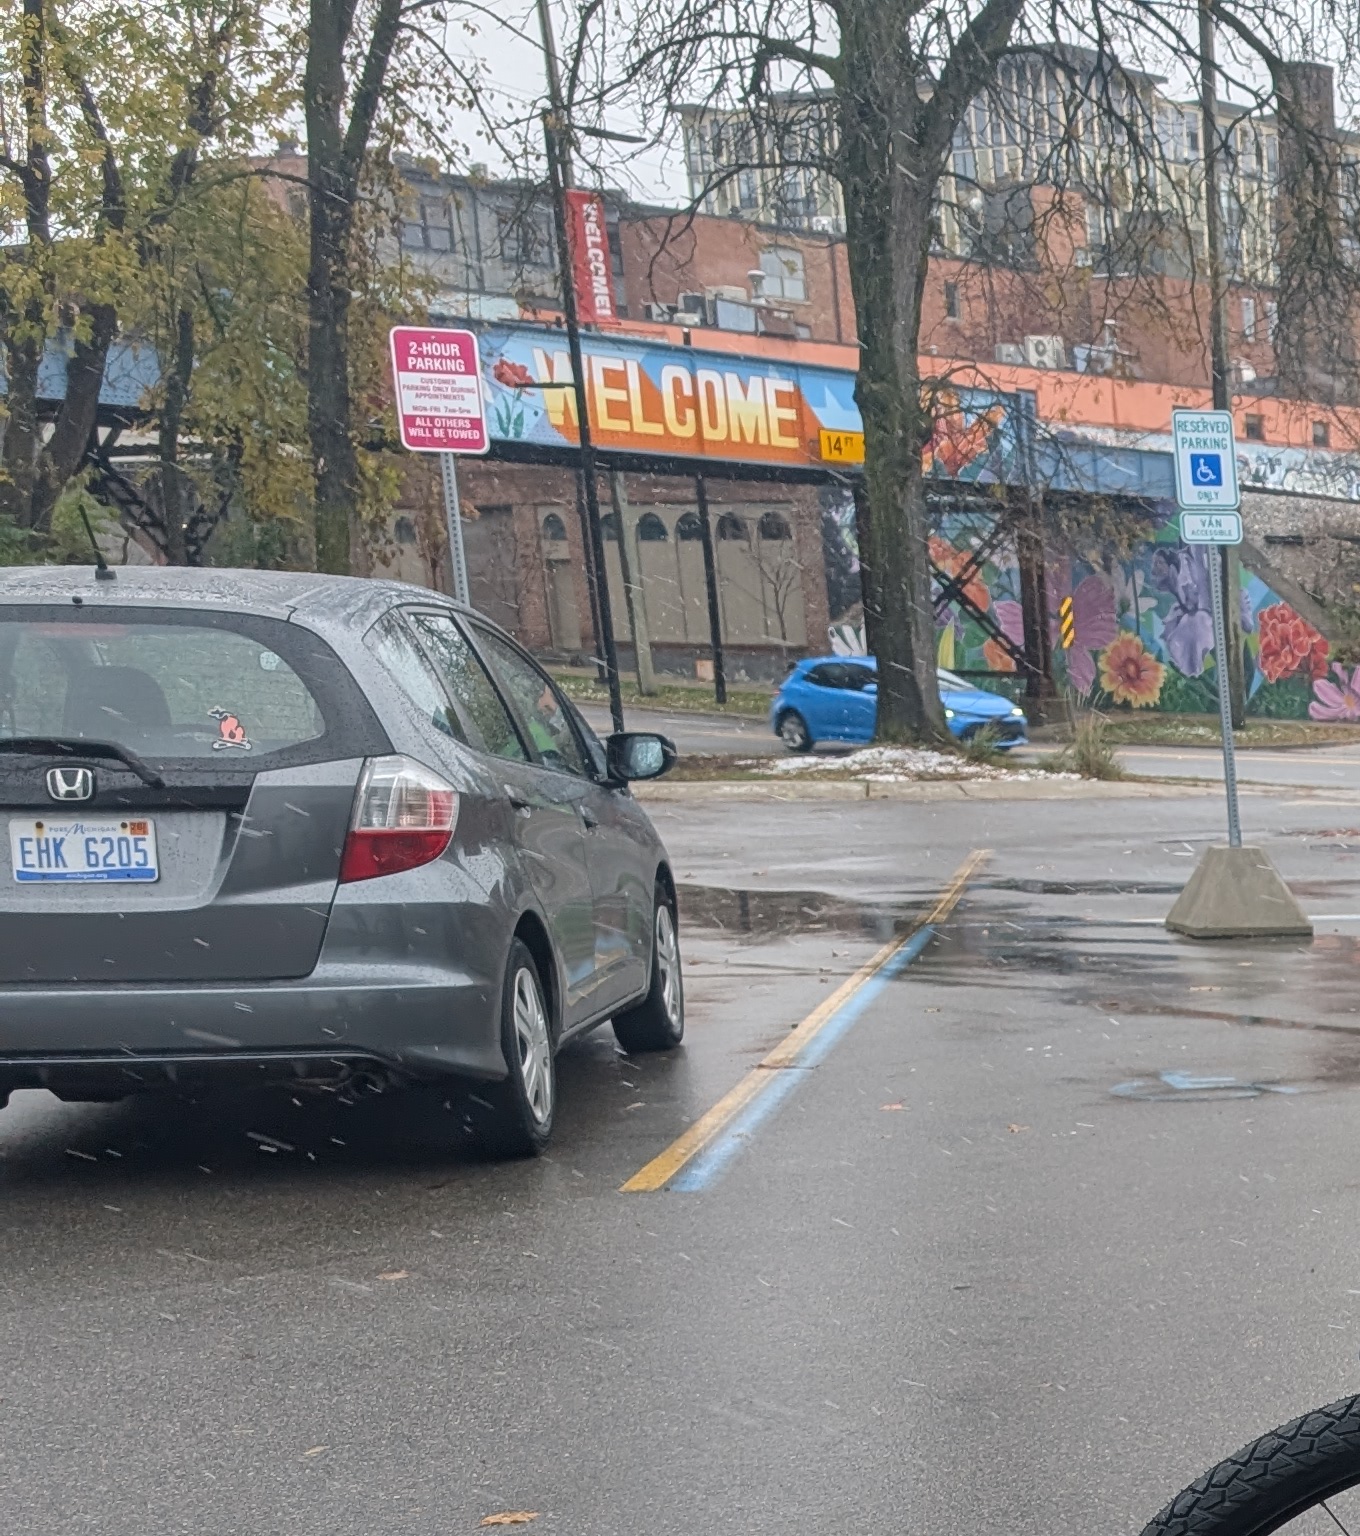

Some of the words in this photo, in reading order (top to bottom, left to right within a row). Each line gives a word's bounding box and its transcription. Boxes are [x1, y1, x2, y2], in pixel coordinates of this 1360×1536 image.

[409, 342, 460, 357] 2-HOUR
[407, 357, 465, 372] PARKING
[415, 393, 465, 401] APPOINTMENTS
[533, 346, 800, 449] WELCOME
[415, 417, 432, 427] ALL
[434, 418, 471, 429] OTHERS
[1177, 420, 1229, 433] RESERVED
[408, 427, 431, 437] WILL
[434, 429, 445, 438] BE
[447, 429, 480, 440] TOWED
[825, 434, 843, 456] 14
[1181, 437, 1228, 450] PARKING
[1197, 491, 1219, 500] ONLY
[1200, 518, 1222, 528] VAN
[1191, 529, 1233, 537] ACCESSIBLE
[19, 837, 68, 868] EHK
[84, 837, 148, 868] 6205
